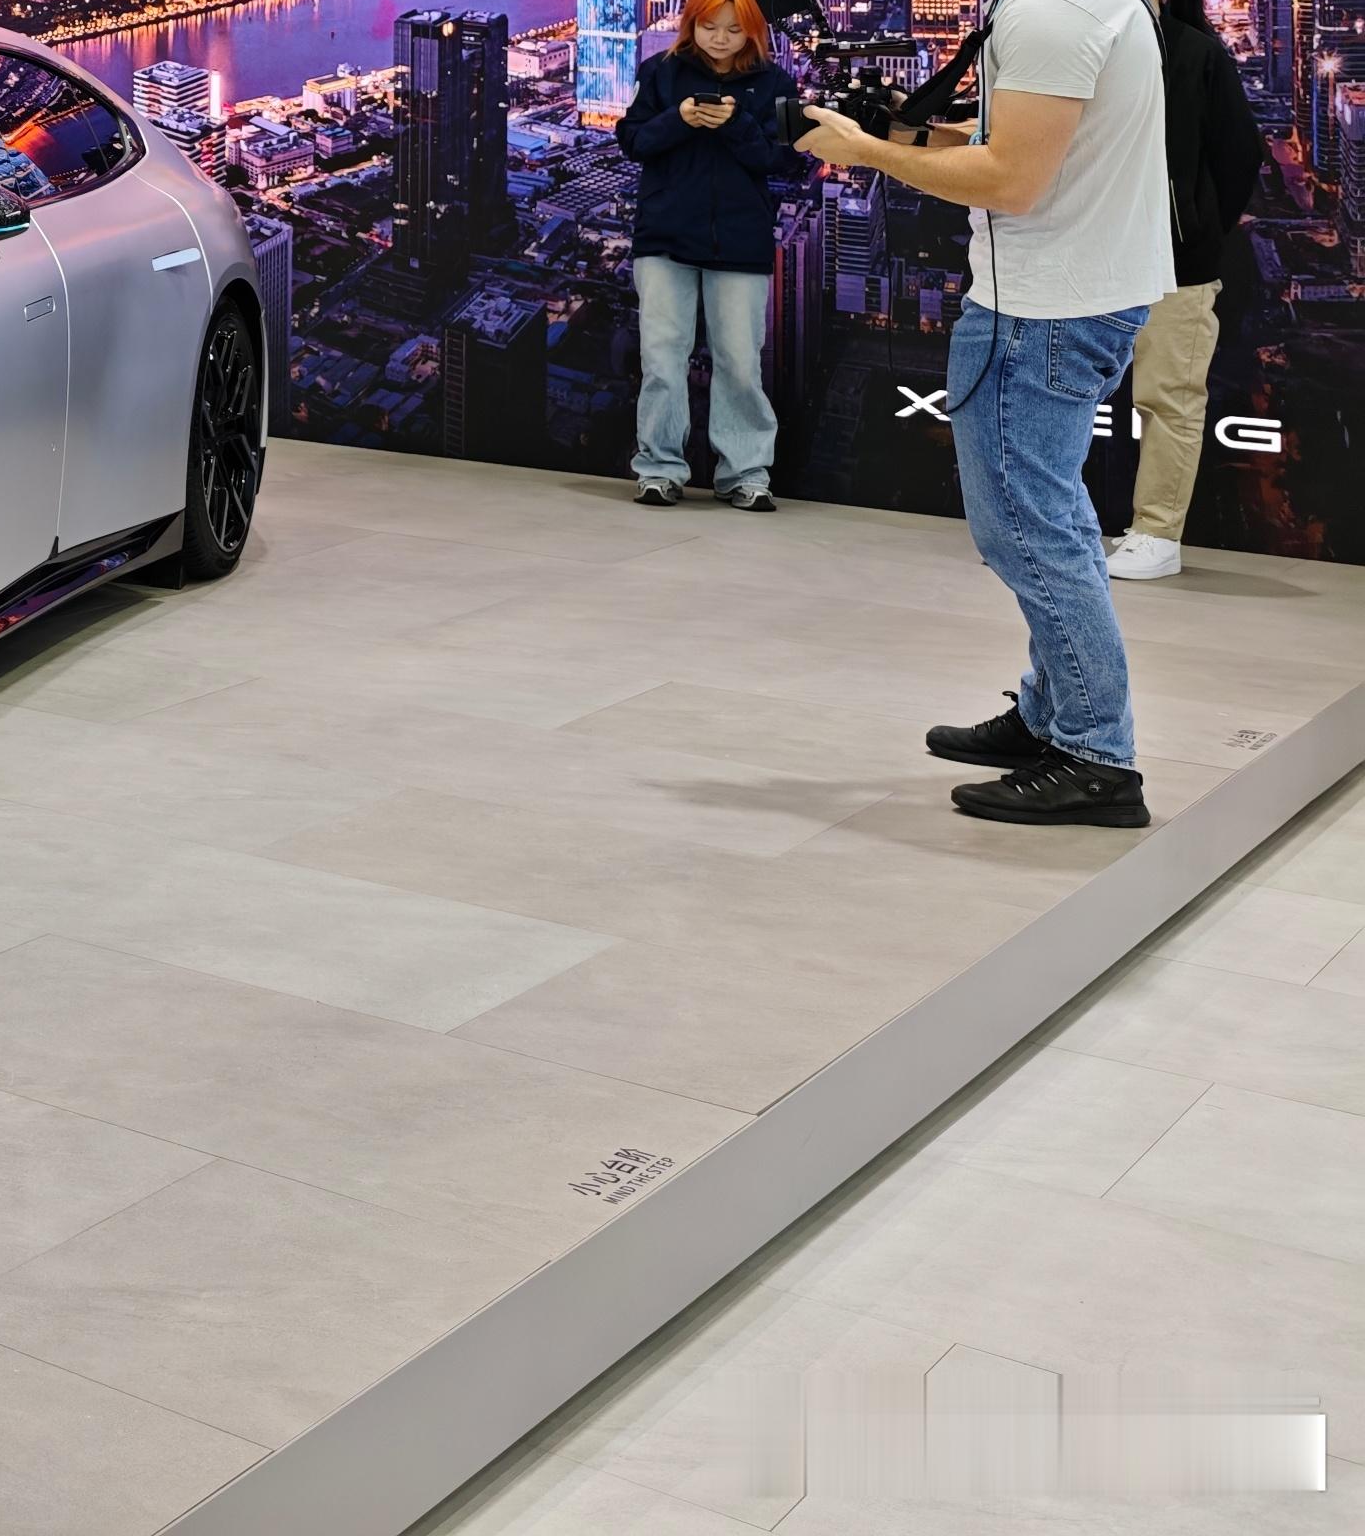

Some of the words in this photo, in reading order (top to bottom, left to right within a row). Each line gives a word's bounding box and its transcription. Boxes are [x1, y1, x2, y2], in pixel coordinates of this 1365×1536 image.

[567, 1147, 657, 1196] 小心台阶
[602, 1184, 637, 1205] MIND
[626, 1171, 657, 1187] THE
[645, 1156, 676, 1175] STEP
